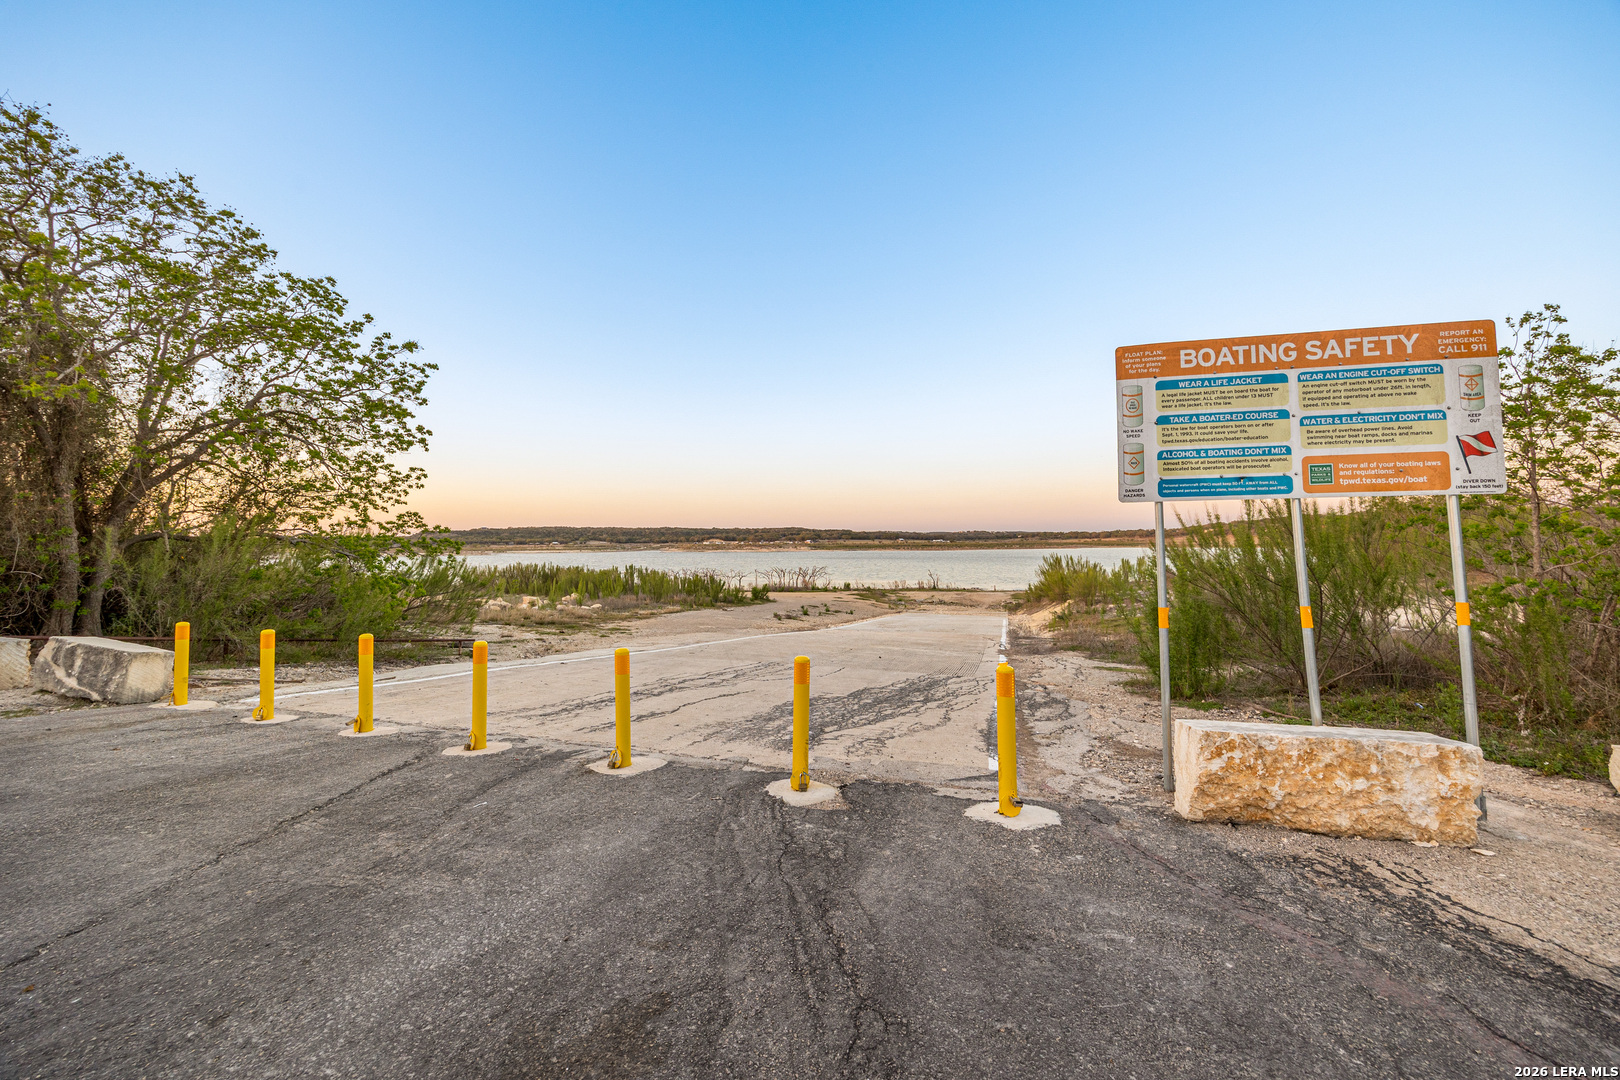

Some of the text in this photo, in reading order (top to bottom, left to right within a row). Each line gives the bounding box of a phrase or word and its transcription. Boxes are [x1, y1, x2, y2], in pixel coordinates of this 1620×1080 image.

[1180, 333, 1419, 368] BOATING SAFETY
[1438, 344, 1487, 354] CALL 911
[1371, 368, 1406, 376] CUT-OFF
[1408, 366, 1441, 374] SWITCH
[1230, 377, 1262, 385] JACKET
[1343, 414, 1396, 423] ELECTRICITY
[1340, 476, 1427, 486] tpwd.texas.gov/boat
